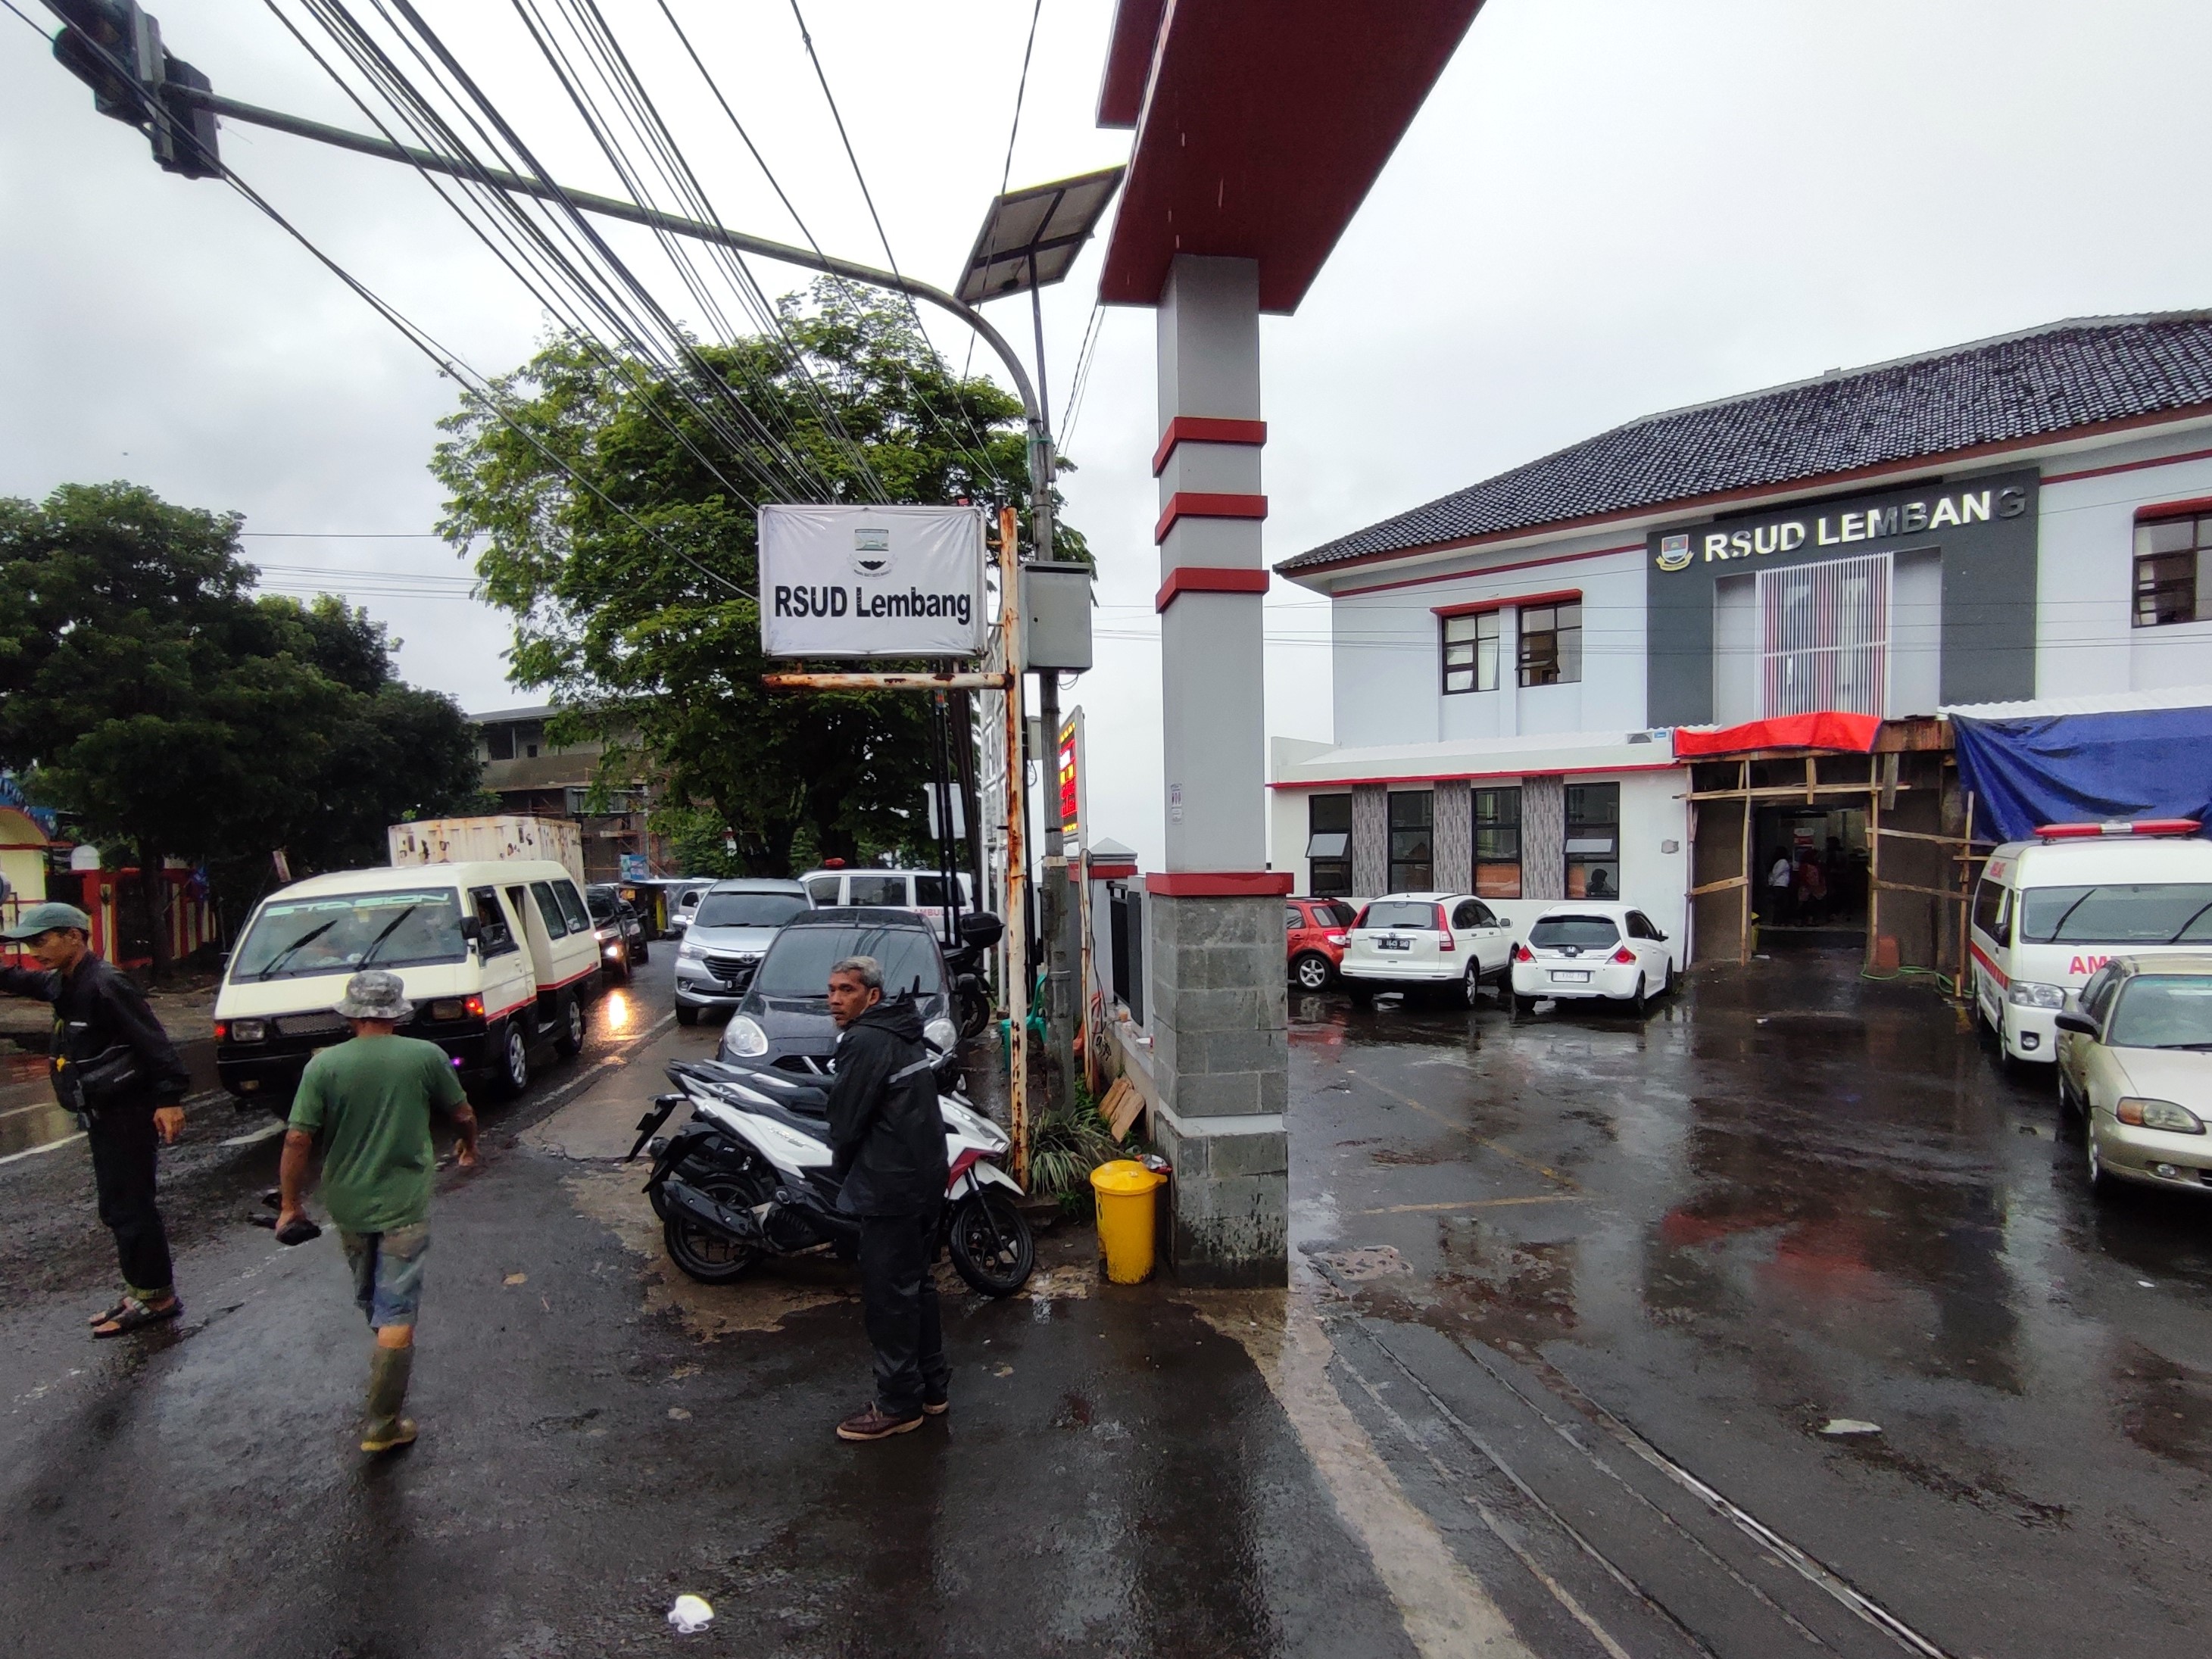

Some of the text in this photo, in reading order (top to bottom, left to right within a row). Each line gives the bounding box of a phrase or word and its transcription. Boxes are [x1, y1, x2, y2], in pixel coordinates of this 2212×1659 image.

[1705, 485, 2026, 562] RSUD LEMBANG
[775, 586, 971, 625] RSUD Lembang
[2068, 956, 2108, 975] AM
